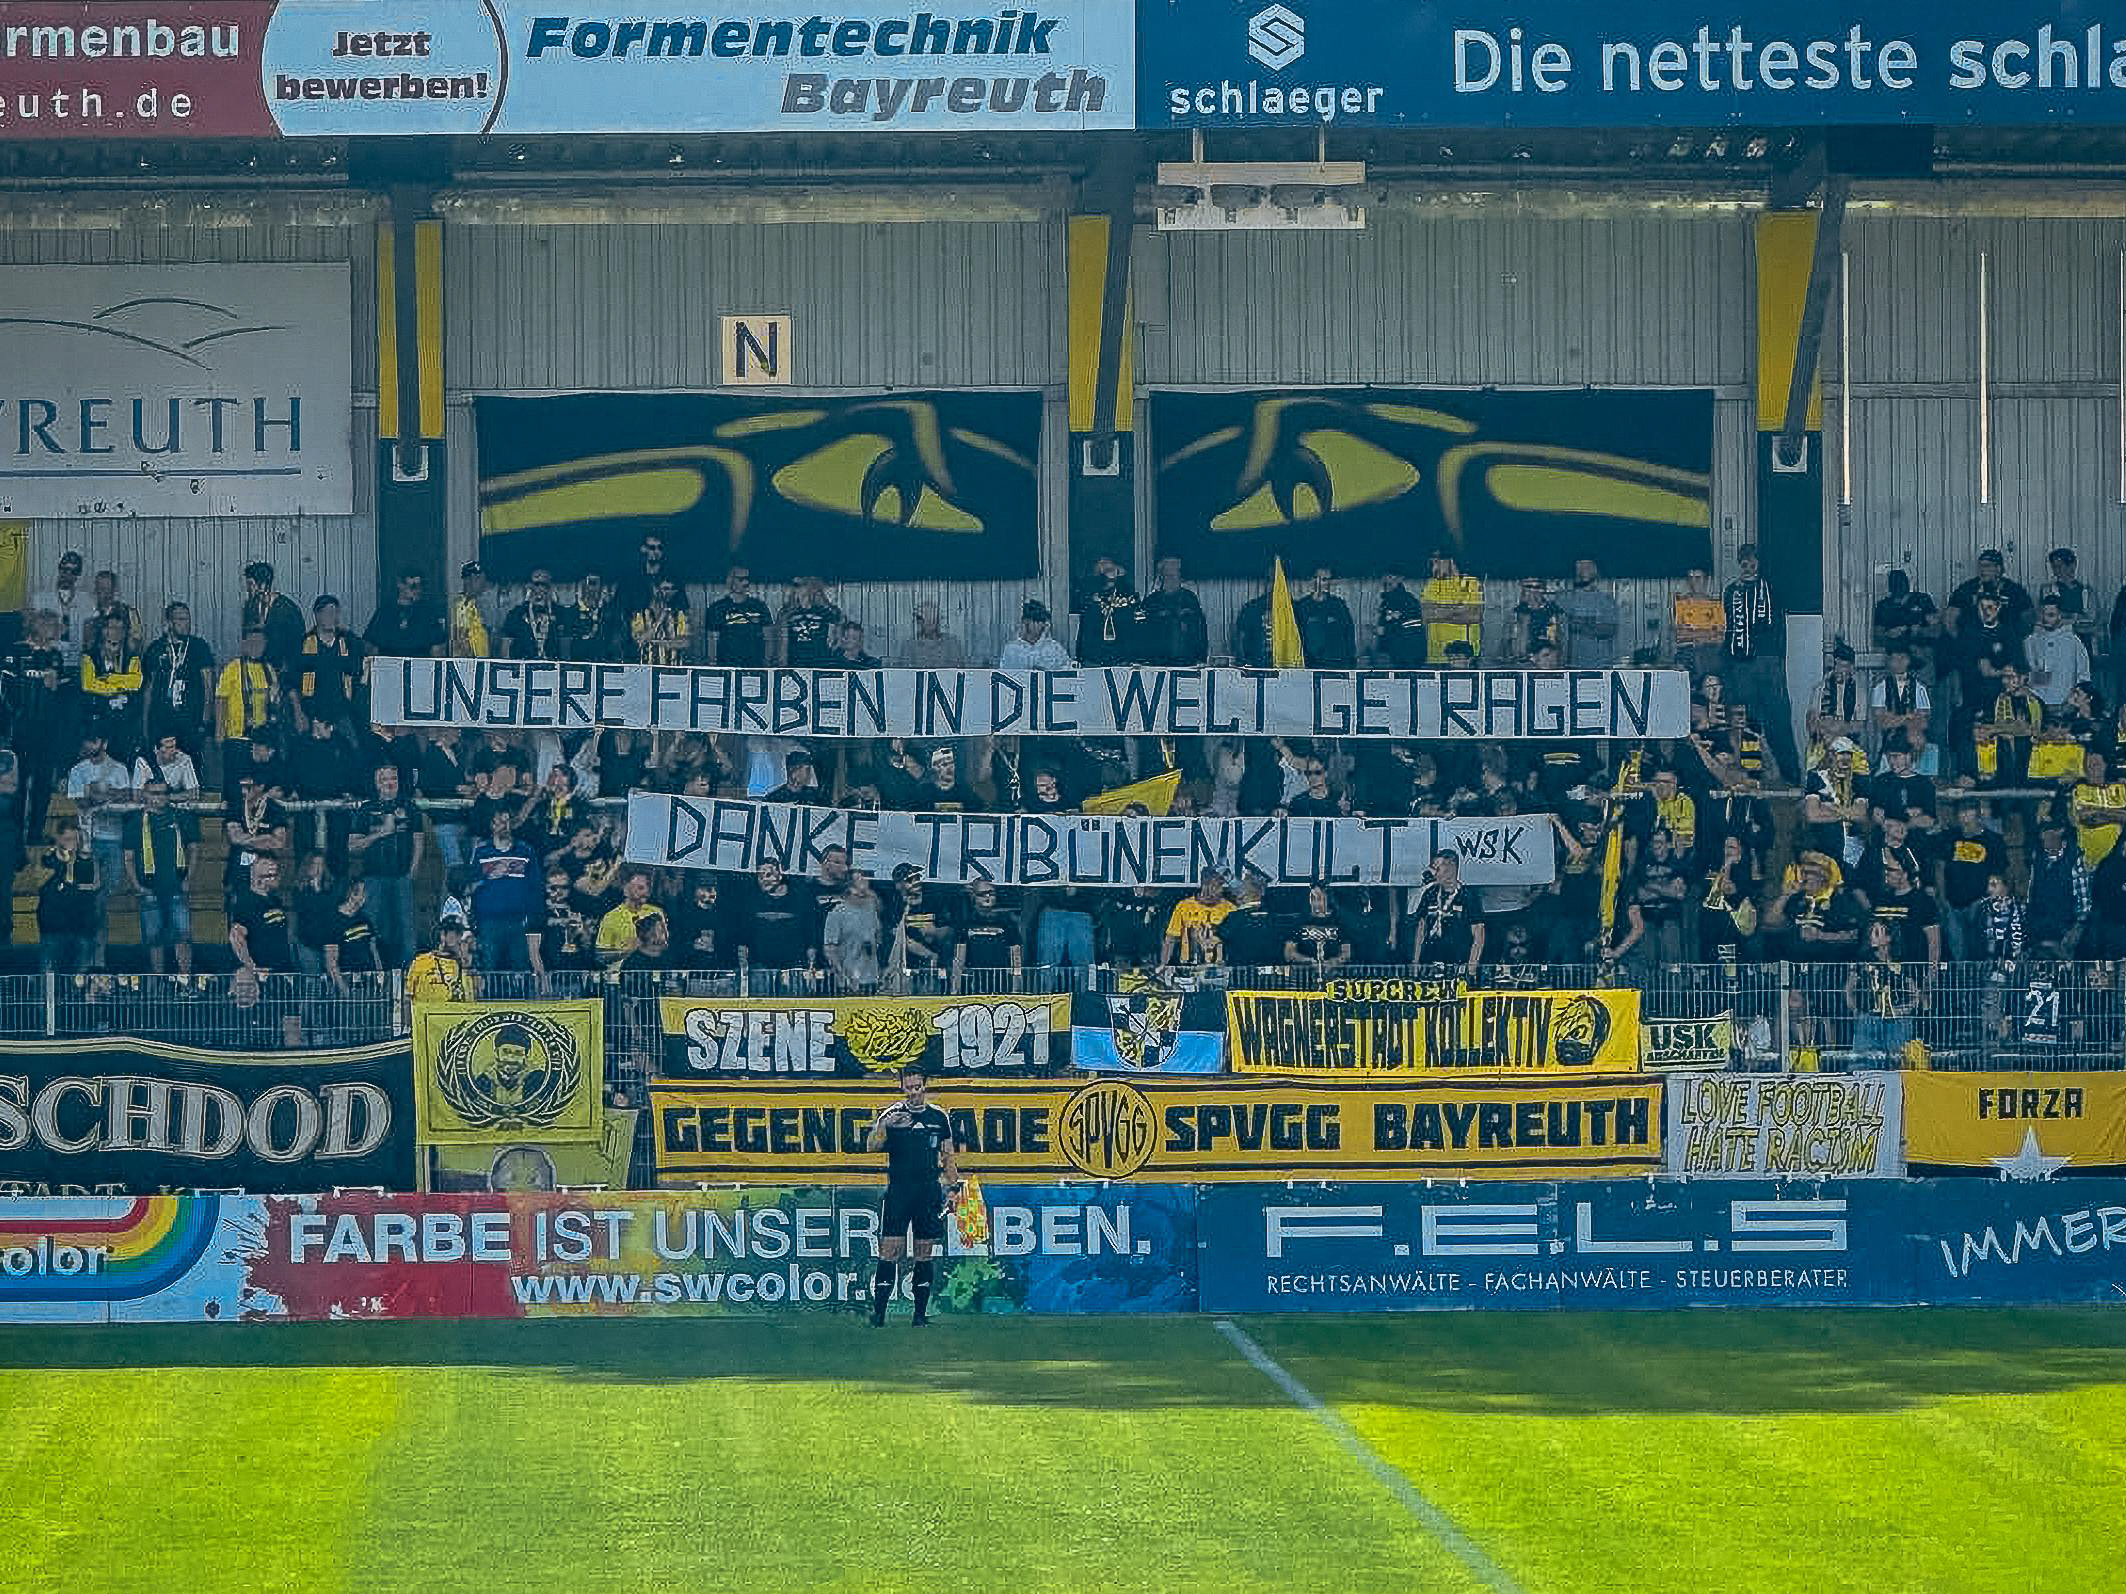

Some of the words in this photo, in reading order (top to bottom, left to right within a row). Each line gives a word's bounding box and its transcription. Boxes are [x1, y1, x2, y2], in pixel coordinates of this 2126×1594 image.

[331, 30, 431, 58] Jetzt
[524, 10, 1061, 58] Formentechnik
[1453, 28, 1572, 93] Die
[1602, 24, 1918, 92] netteste
[0, 87, 192, 118] uth.de
[275, 72, 489, 101] bewerben!
[780, 69, 1106, 121] Bayreuth
[1169, 79, 1384, 120] schlaeger
[735, 321, 778, 378] N
[0, 398, 301, 453] REUTH
[403, 660, 624, 727] UNSERE
[652, 666, 885, 735] FARBEN
[915, 671, 964, 735] IN
[991, 671, 1077, 733] DIE
[1103, 670, 1279, 733] WELT
[1313, 670, 1652, 737] GETRAGEN
[667, 795, 879, 878] DANKE
[1455, 825, 1524, 865] WSK
[1334, 979, 1458, 1002] SUPCREW
[2025, 990, 2060, 1026] 21
[684, 1007, 836, 1073] SZENE
[931, 1002, 1052, 1069] 1921
[0, 1074, 392, 1162] SCHDOD
[662, 1106, 1051, 1155] GEGENGADE
[1164, 1103, 1341, 1152] SPVGG
[1372, 1098, 1651, 1151] BAYREUTH
[1681, 1079, 1751, 1125] LOVE
[1757, 1079, 1886, 1127] FOOTBALL
[1977, 1087, 2083, 1119] FORZA
[1684, 1125, 1760, 1172] HATE
[288, 1211, 511, 1264] FARBE
[536, 1209, 635, 1262] IST
[655, 1208, 880, 1260] UNSER
[1940, 1206, 2126, 1278] IMMER
[1266, 1270, 1461, 1294] RECHTSANWÄLTE
[1484, 1267, 1651, 1291] FACHANWÄLTE
[1675, 1269, 1848, 1289] STEUERBERATER
